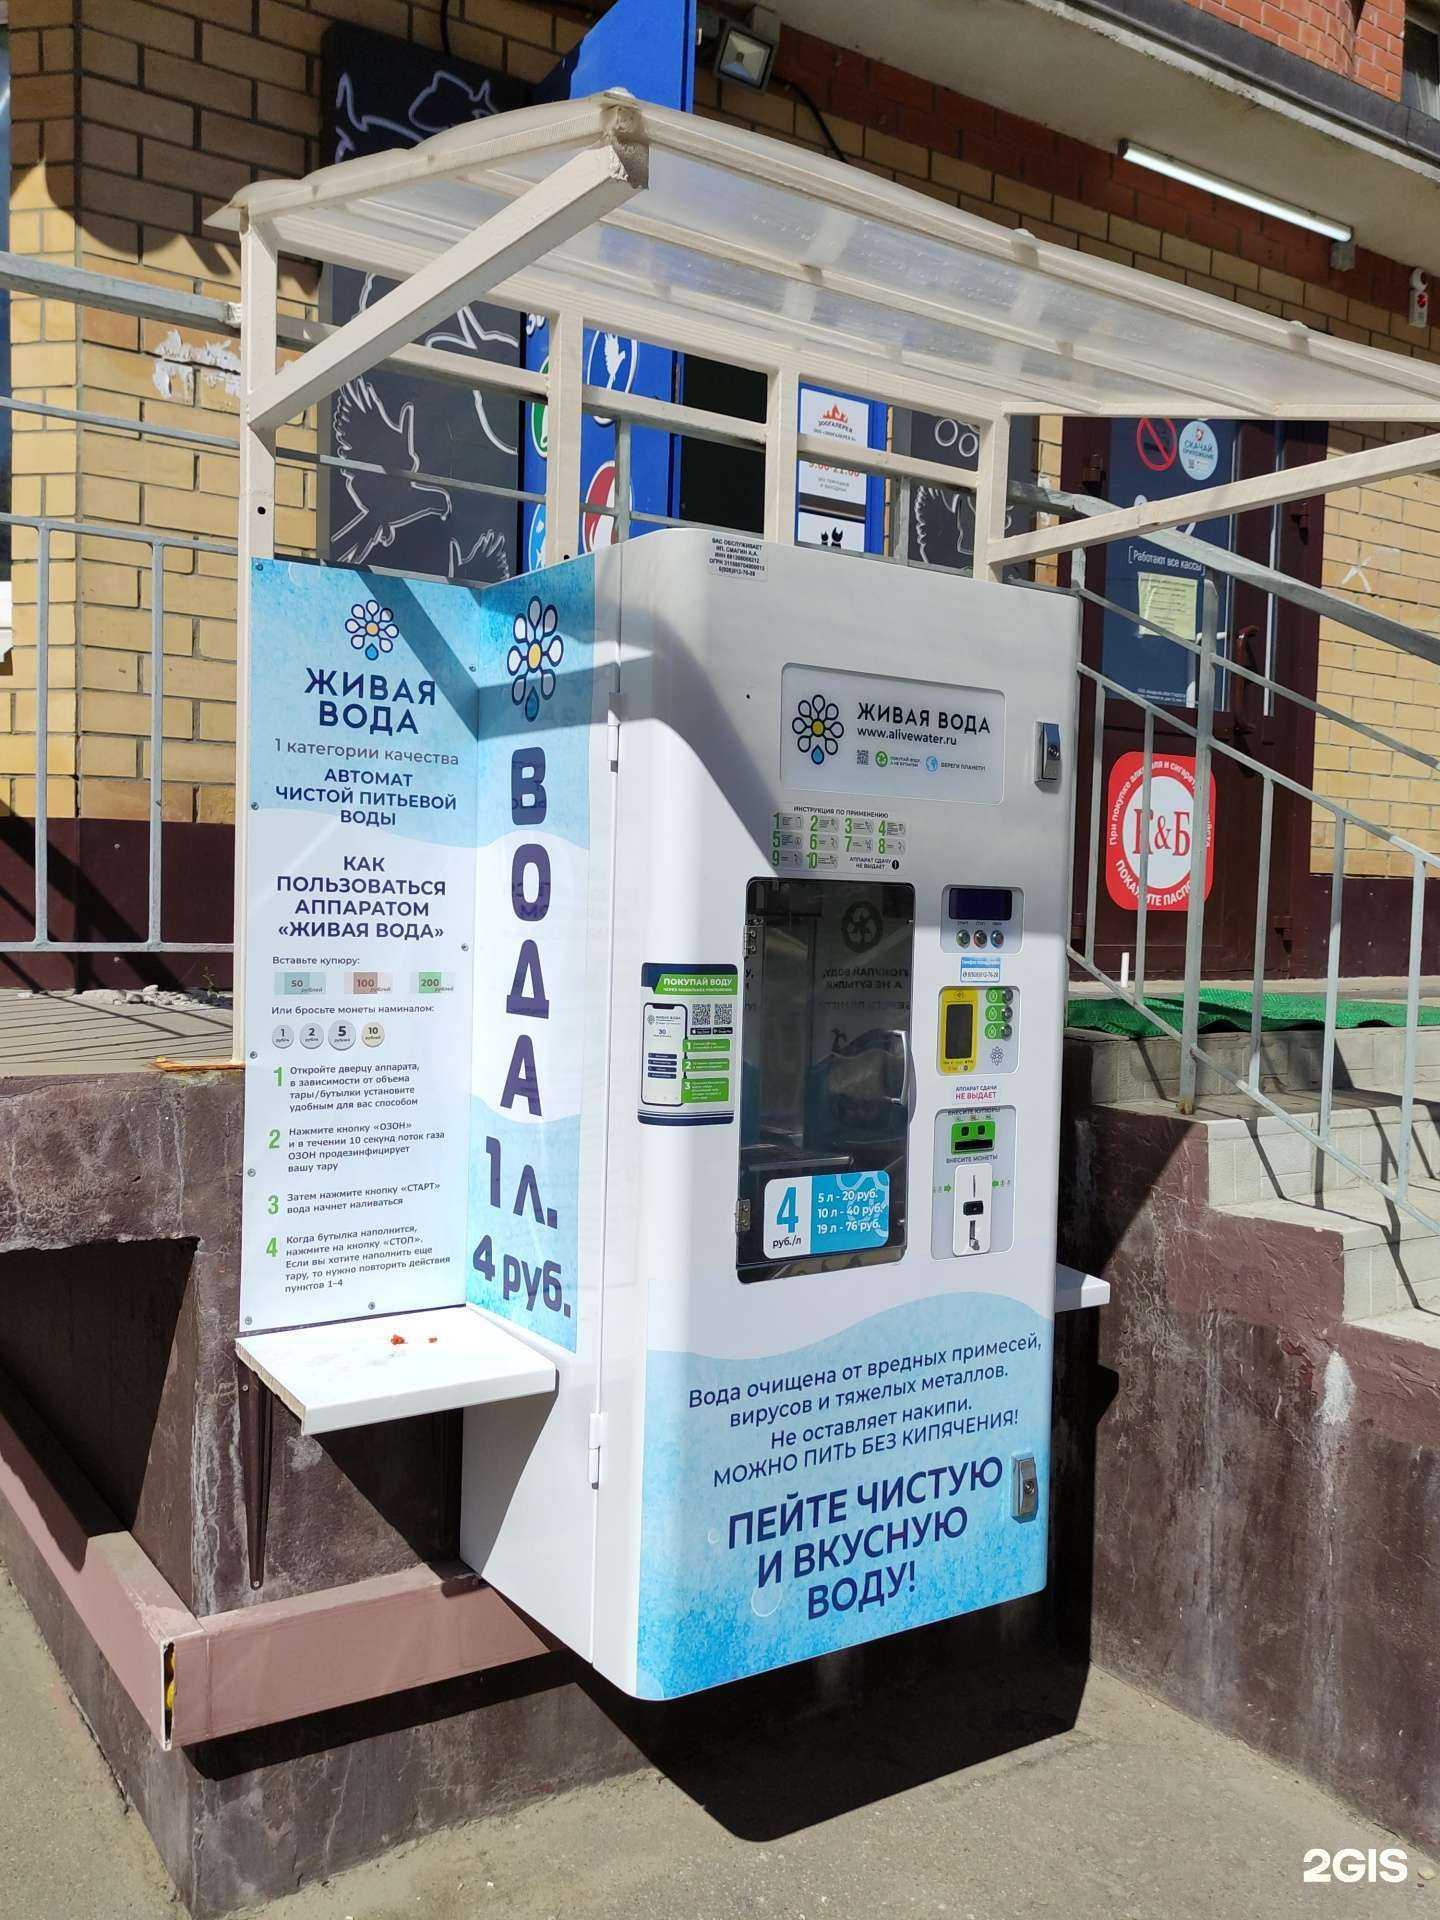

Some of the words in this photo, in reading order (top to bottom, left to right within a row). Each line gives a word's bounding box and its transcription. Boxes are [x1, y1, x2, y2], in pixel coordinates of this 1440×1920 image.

[305, 668, 436, 706] ЖИВАЯ
[319, 701, 419, 736] ВОДА
[857, 702, 929, 728] ЖИВАЯ
[938, 712, 990, 735] ВОДА
[857, 726, 957, 746] www.alivewater.ru
[275, 738, 281, 752] 1
[287, 742, 379, 760] категории
[385, 749, 459, 766] качества
[324, 768, 413, 787] АВТОМАТ
[276, 785, 353, 805] ЧИСТОЙ
[360, 790, 456, 810] ПИТЬЕВОЙ
[340, 809, 396, 827] ВОДЫ
[794, 806, 834, 814] ИНСТРУКЦИЯ
[846, 810, 888, 819] ПРИМЕНЕНИЮ
[773, 813, 780, 829] 1
[811, 816, 818, 832] 2
[845, 818, 852, 834] 3
[879, 820, 886, 836] 4
[773, 831, 780, 847] 5
[810, 834, 817, 849] 6
[845, 836, 852, 852] 7
[879, 838, 885, 854] 8
[343, 856, 385, 872] КАК
[773, 850, 779, 866] 9
[806, 853, 817, 868] 10
[277, 876, 446, 896] ПОЛЬЗОВАТЬСЯ
[295, 899, 429, 917] АППАРАТОМ
[278, 922, 369, 939] «ЖИВАЯ
[376, 923, 444, 941] ВОДА»
[272, 956, 317, 965] Вставьте
[320, 957, 360, 966] купюру:
[357, 979, 374, 987] 100
[421, 979, 439, 987] 200
[664, 977, 708, 986] ПОКУПАЙ
[710, 978, 732, 987] ВОДУ
[272, 1006, 292, 1015] Или
[295, 1006, 335, 1016] бросьте
[338, 1006, 376, 1014] монеты
[378, 1005, 434, 1013] наминалом:
[308, 1028, 315, 1036] 2
[338, 1026, 346, 1037] 5
[273, 1067, 282, 1087] 1
[290, 1066, 336, 1075] Откройте
[339, 1065, 372, 1074] дверцу
[375, 1064, 419, 1072] аппарата,
[298, 1077, 360, 1087] зависимости
[290, 1089, 361, 1100] тары/бутылки
[364, 1087, 415, 1096] установите
[956, 1092, 967, 1100] НЕ
[968, 1092, 996, 1101] ВЫДАЕТ
[290, 1102, 333, 1112] удобным
[337, 1102, 353, 1110] для
[375, 1099, 418, 1107] способом
[269, 1129, 281, 1149] 2
[289, 1127, 333, 1136] Нажмите
[337, 1125, 370, 1134] кнопку
[374, 1122, 412, 1130] «ОЗОН»
[307, 1138, 346, 1147] течении
[364, 1135, 395, 1144] секунд
[398, 1133, 423, 1141] поток
[426, 1132, 445, 1140] газа
[288, 1152, 316, 1160] ОЗОН
[319, 1146, 410, 1160] продезинфицирует
[288, 1164, 313, 1172] вашу
[317, 1162, 338, 1172] тару
[486, 1136, 501, 1208] 1
[268, 1195, 278, 1214] 3
[287, 1193, 316, 1202] Затем
[320, 1190, 362, 1199] нажмите
[365, 1187, 398, 1197] кнопку
[401, 1183, 440, 1192] «СТАРТ»
[818, 1193, 824, 1203] 5
[842, 1191, 854, 1200] 20
[857, 1188, 878, 1201] руб.
[288, 1205, 310, 1215] вода
[313, 1202, 346, 1211] начнет
[350, 1198, 403, 1209] наливаться
[777, 1187, 798, 1233] 4
[818, 1208, 828, 1218] 10
[847, 1206, 859, 1214] 40
[817, 1224, 827, 1234] 19
[845, 1221, 857, 1231] 76
[860, 1219, 881, 1232] руб.
[266, 1237, 277, 1257] 4
[287, 1235, 314, 1245] Когда
[318, 1231, 358, 1242] бутылка
[361, 1225, 417, 1237] наполнится,
[287, 1246, 329, 1256] нажмите
[347, 1241, 380, 1250] кнопку
[772, 1235, 802, 1249] руб./л
[286, 1259, 308, 1268] Если
[329, 1254, 359, 1264] хотите
[362, 1249, 412, 1260] наполнить
[414, 1247, 432, 1255] еще
[286, 1272, 309, 1282] тару,
[326, 1266, 356, 1277] нужно
[359, 1261, 407, 1272] повторить
[409, 1256, 450, 1267] действия
[473, 1235, 496, 1281] 4
[503, 1254, 571, 1318] руб.
[285, 1282, 324, 1293] пунктов
[689, 1384, 740, 1408] Вода
[747, 1366, 836, 1398] очищена
[842, 1362, 860, 1382] от
[868, 1351, 946, 1378] вредных
[951, 1333, 1042, 1364] примесей,
[730, 1396, 812, 1427] вирусов
[818, 1392, 829, 1410] и
[836, 1378, 916, 1407] тяжелых
[922, 1364, 1008, 1393] металлов.
[771, 1427, 796, 1448] Не
[803, 1409, 896, 1445] оставляет
[902, 1398, 972, 1422] накипи.
[713, 1453, 798, 1487] МОЖНО
[804, 1442, 856, 1468] ПИТЬ
[862, 1434, 896, 1456] БЕЗ
[902, 1409, 1018, 1447] КИПЯЧЕНИЯ!
[729, 1489, 847, 1550] ПЕЙТЕ
[857, 1456, 1003, 1514] ЧИСТУЮ
[758, 1550, 782, 1588] И
[794, 1506, 968, 1578] ВКУСНУЮ
[808, 1560, 916, 1620] ВОДУ!
